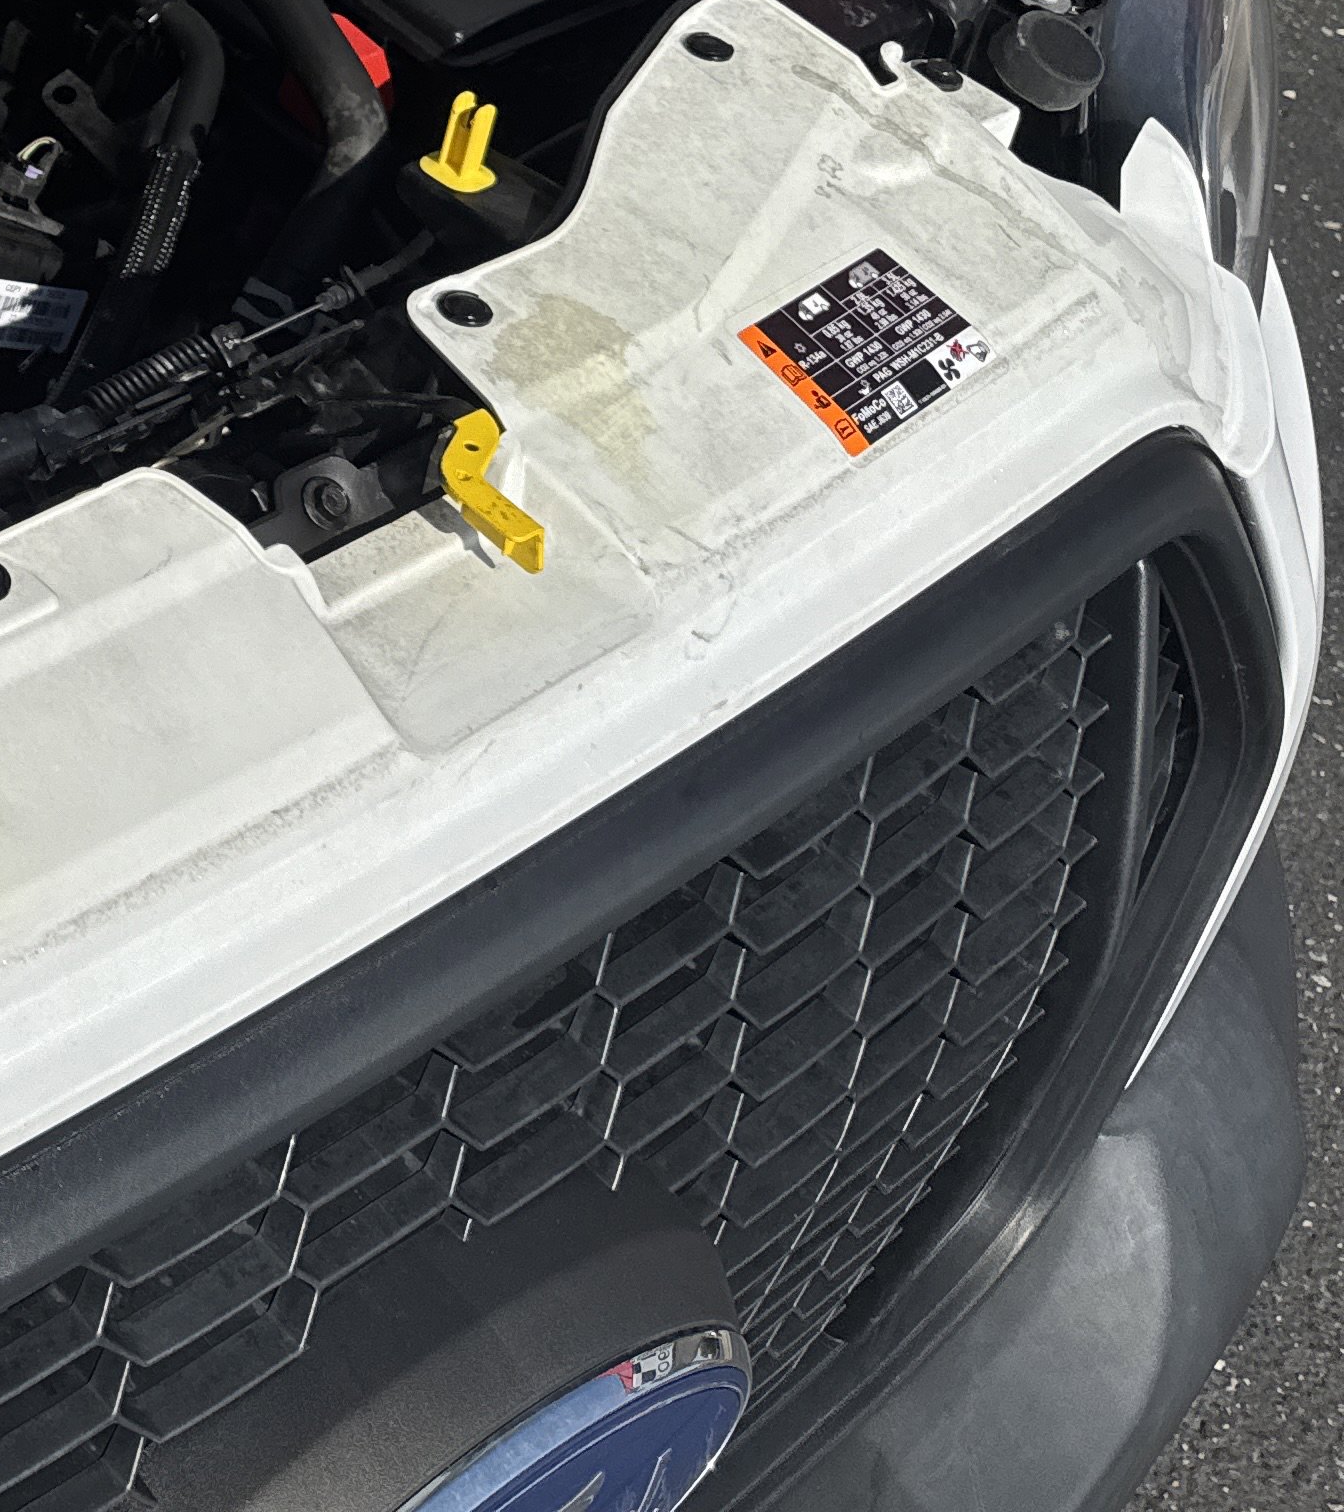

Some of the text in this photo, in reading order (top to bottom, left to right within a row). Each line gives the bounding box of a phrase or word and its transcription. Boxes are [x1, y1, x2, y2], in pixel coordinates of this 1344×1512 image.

[894, 309, 932, 335] GWP 1430
[798, 350, 827, 370] R-134a
[844, 340, 883, 369] GWP 1430
[871, 366, 893, 383] PAG
[851, 397, 887, 425] FoMoCo
[863, 419, 880, 434] SAE
